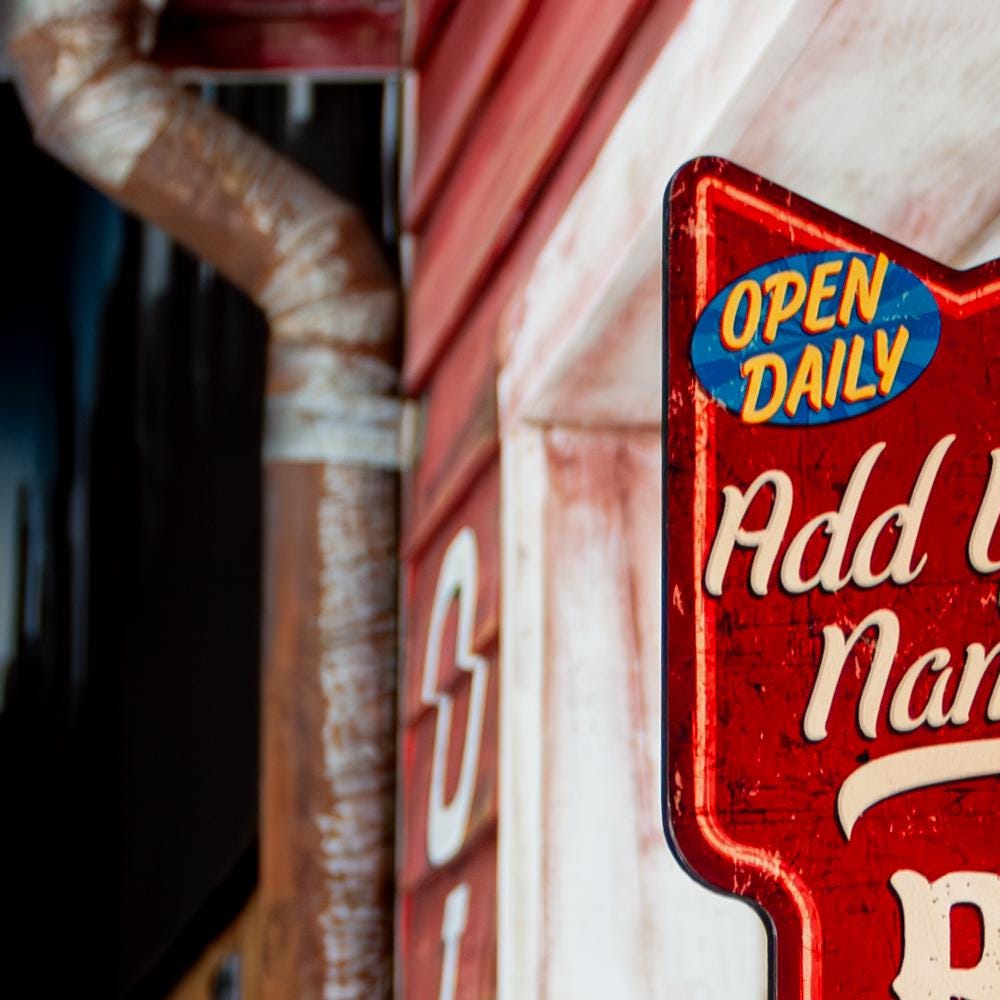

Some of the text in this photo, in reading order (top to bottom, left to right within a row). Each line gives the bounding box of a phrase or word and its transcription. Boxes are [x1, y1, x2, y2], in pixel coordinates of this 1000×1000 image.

[720, 252, 888, 350] OPEN
[740, 325, 909, 424] DAILY
[705, 433, 957, 597] Add
